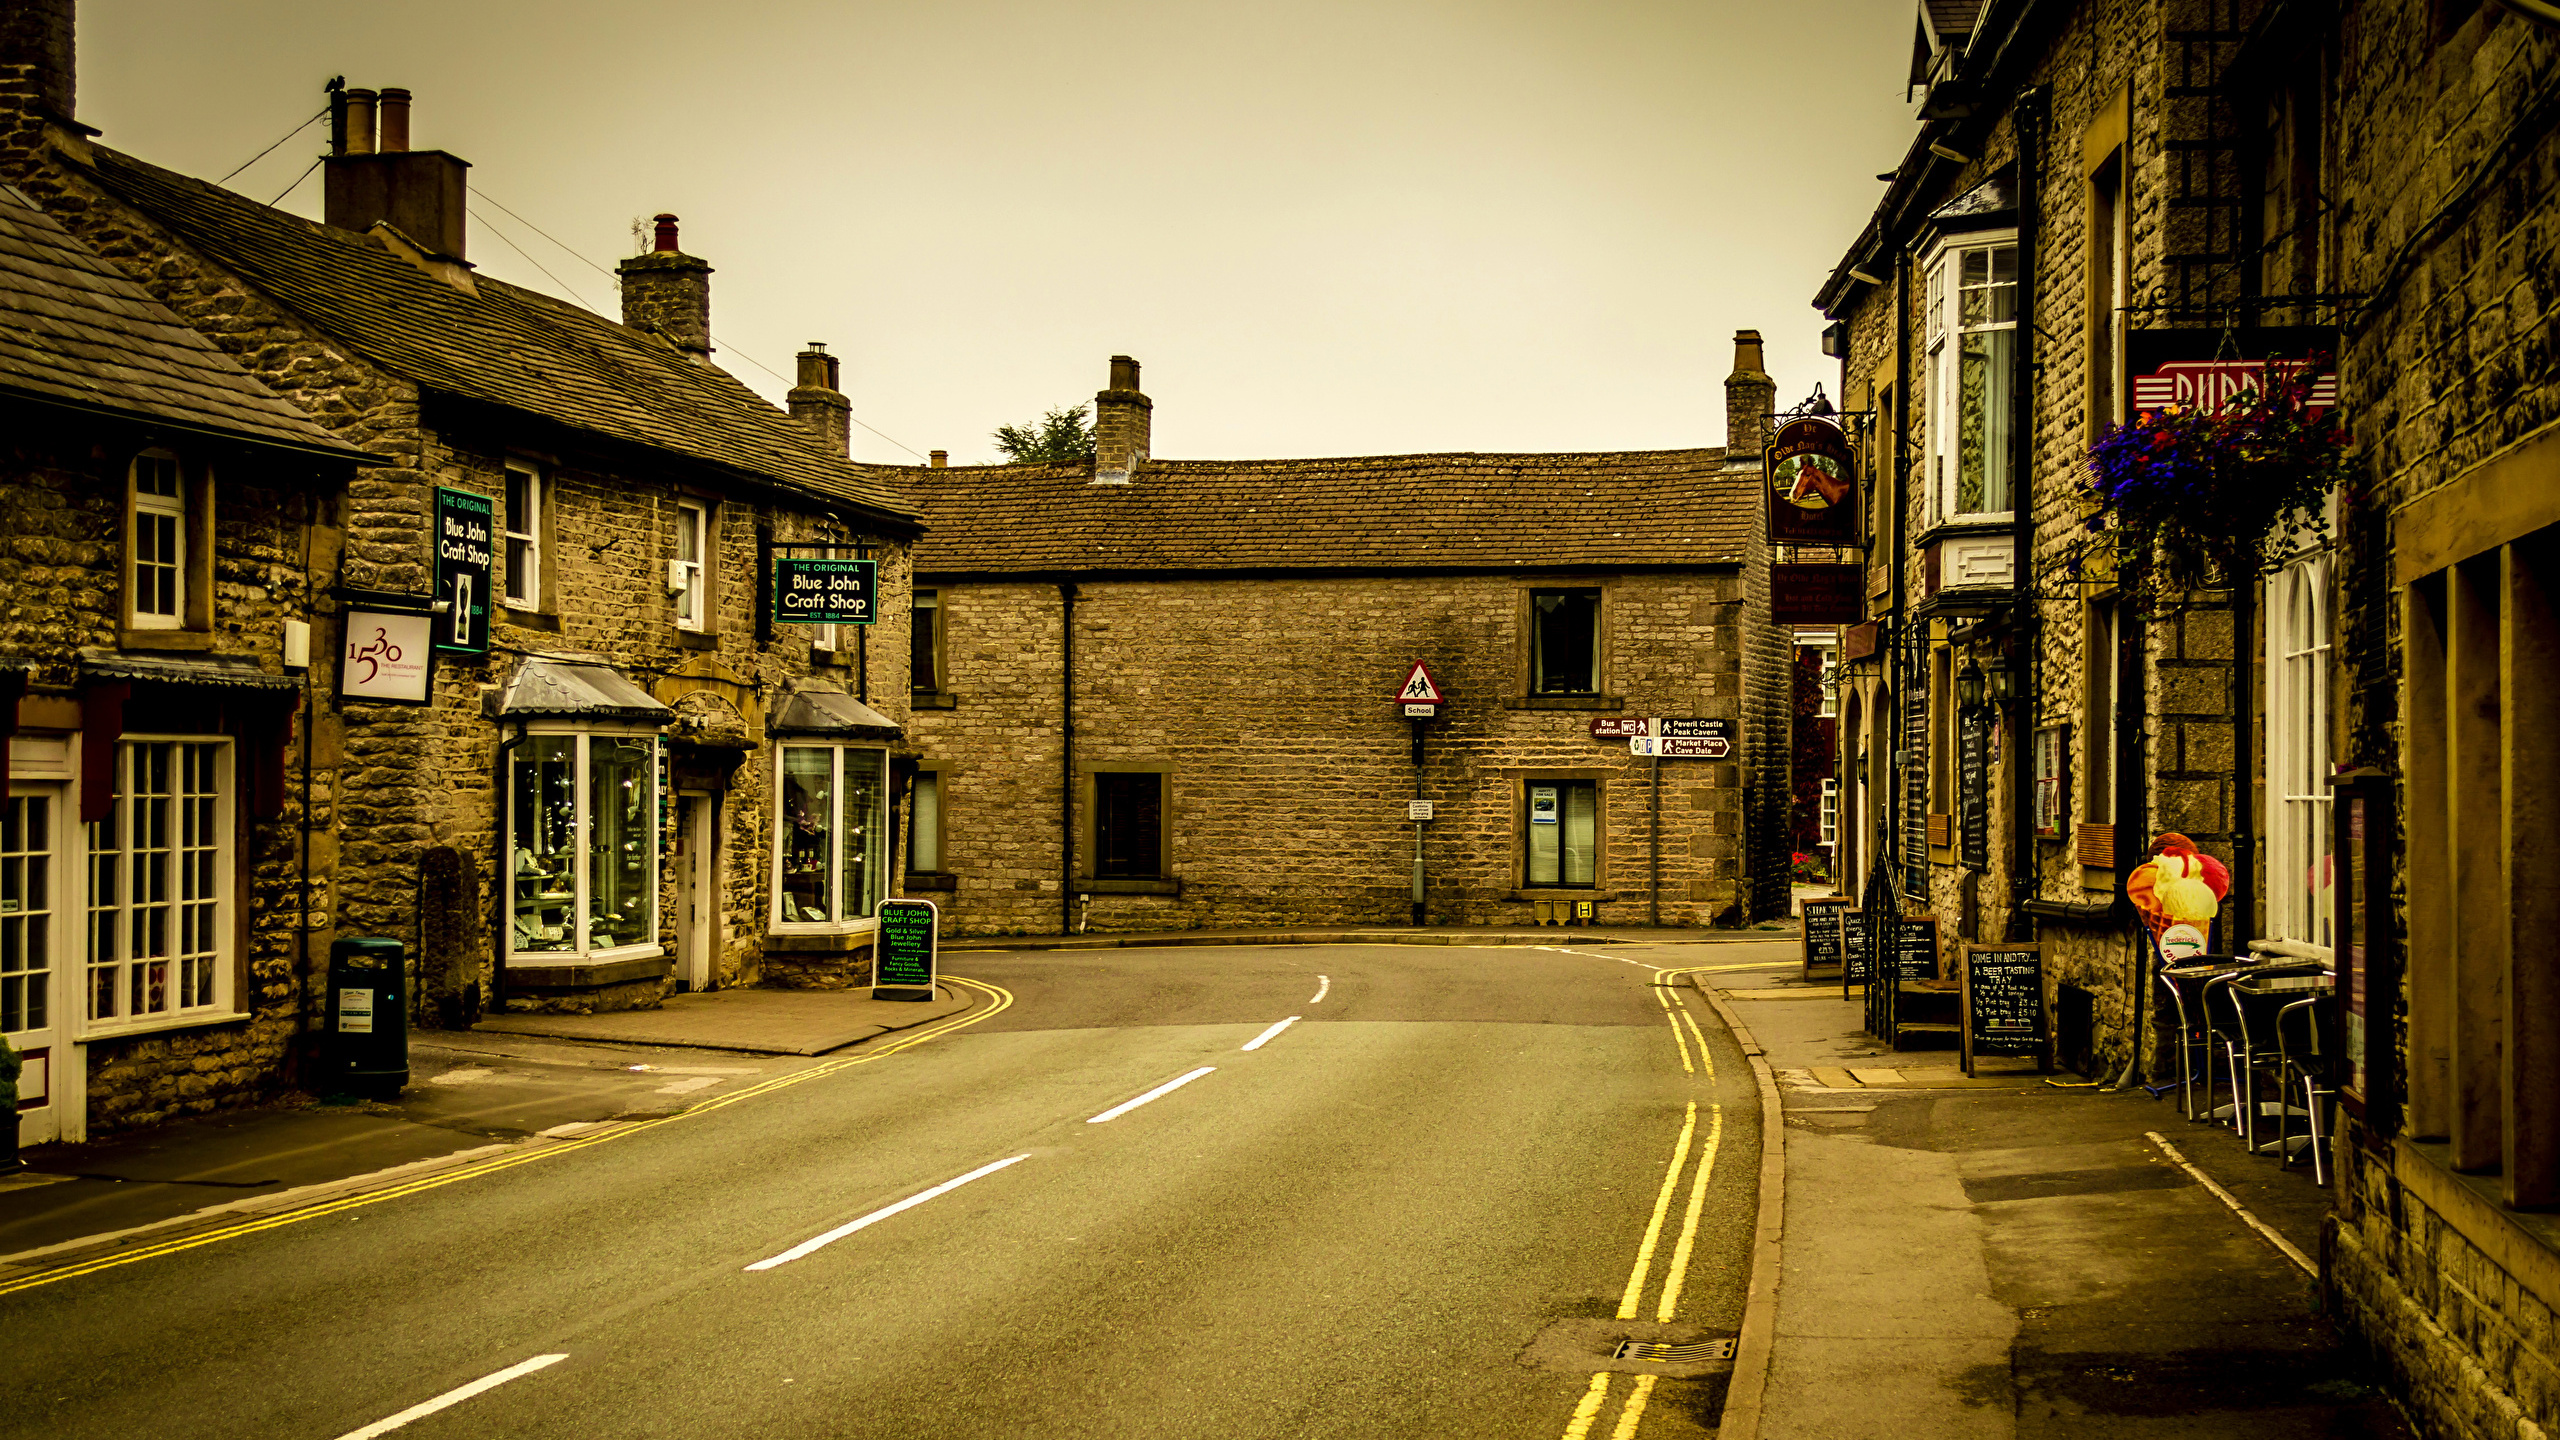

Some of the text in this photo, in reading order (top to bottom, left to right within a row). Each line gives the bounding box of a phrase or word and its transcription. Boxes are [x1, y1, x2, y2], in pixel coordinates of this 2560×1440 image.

[442, 494, 490, 515] THE ORIGINAL
[446, 516, 486, 542] Blue John
[440, 539, 489, 571] Craft Shop
[793, 563, 860, 573] THE ORIGINAL
[792, 574, 860, 591] Blue John
[784, 592, 867, 615] Craft Shop
[1673, 720, 1697, 728] Peveril
[1595, 727, 1620, 735] station
[1693, 729, 1718, 737] Cavern
[1703, 741, 1724, 749] Place
[907, 909, 929, 917] JOHN
[1580, 903, 1590, 916] H
[910, 917, 932, 925] SHOP
[1993, 953, 2002, 963] IN
[2003, 953, 2017, 963] AND
[1974, 966, 2035, 976] A BEER TASTING
[1988, 975, 2012, 984] TRAY
[1985, 997, 1997, 1005] Pint
[1985, 1007, 1997, 1016] Pint
